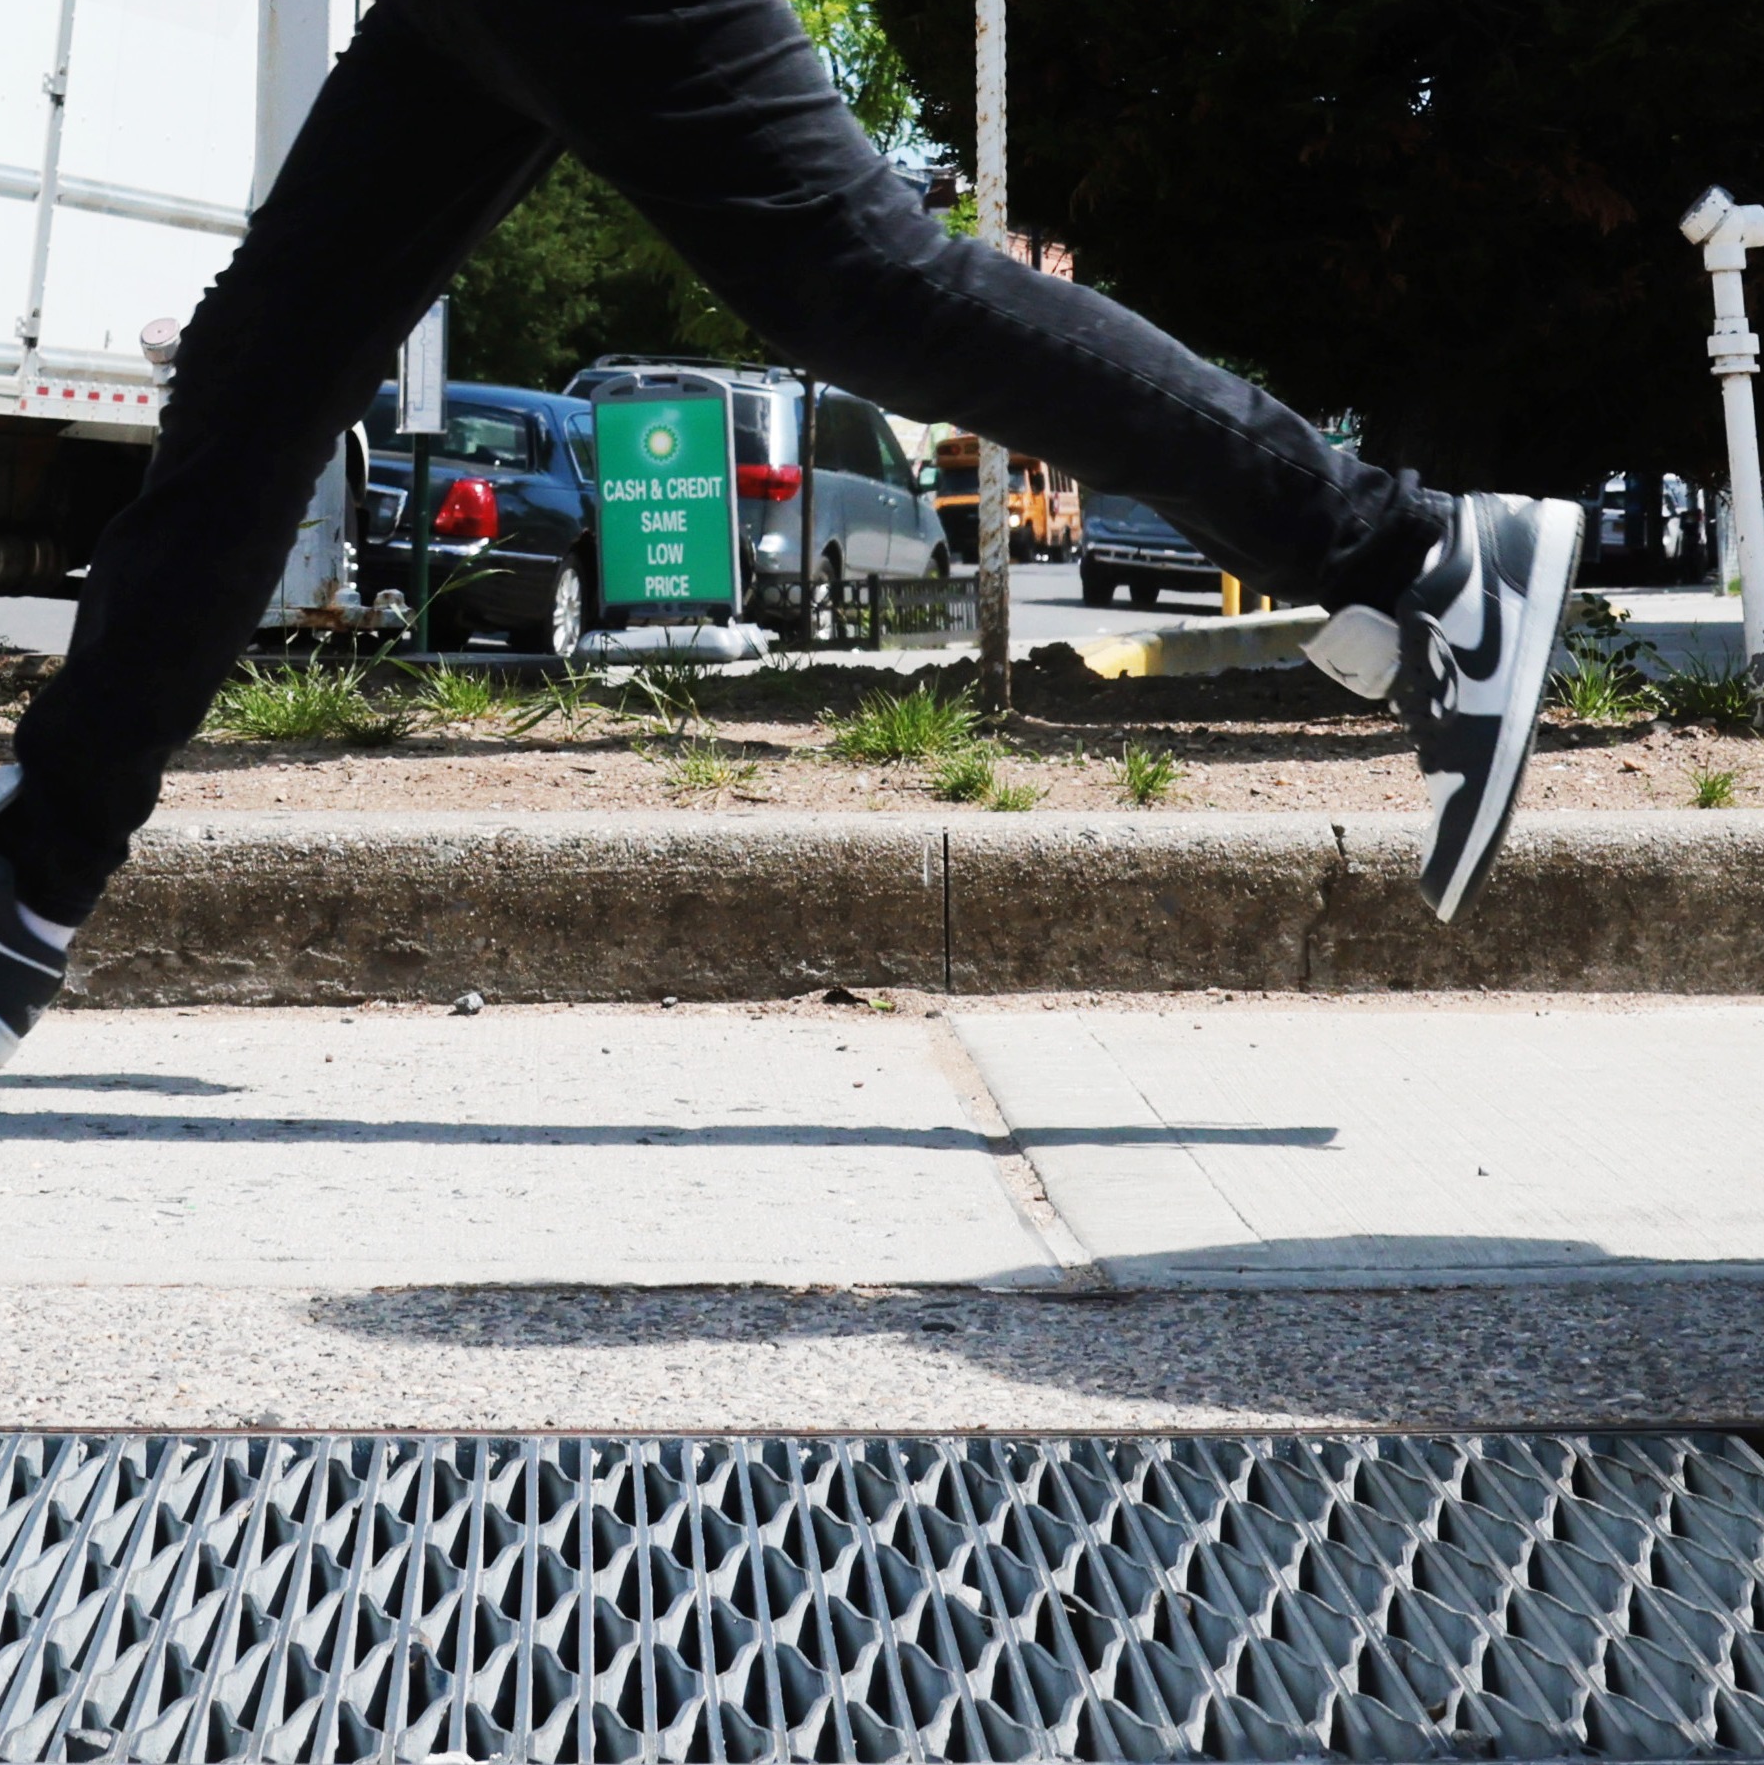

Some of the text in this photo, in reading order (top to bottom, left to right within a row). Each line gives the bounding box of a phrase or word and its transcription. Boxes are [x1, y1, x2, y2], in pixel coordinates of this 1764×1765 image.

[603, 476, 723, 502] CASH & CREDIT
[640, 510, 688, 533] SAME
[647, 543, 684, 565] LOW
[644, 575, 690, 598] PRICE
